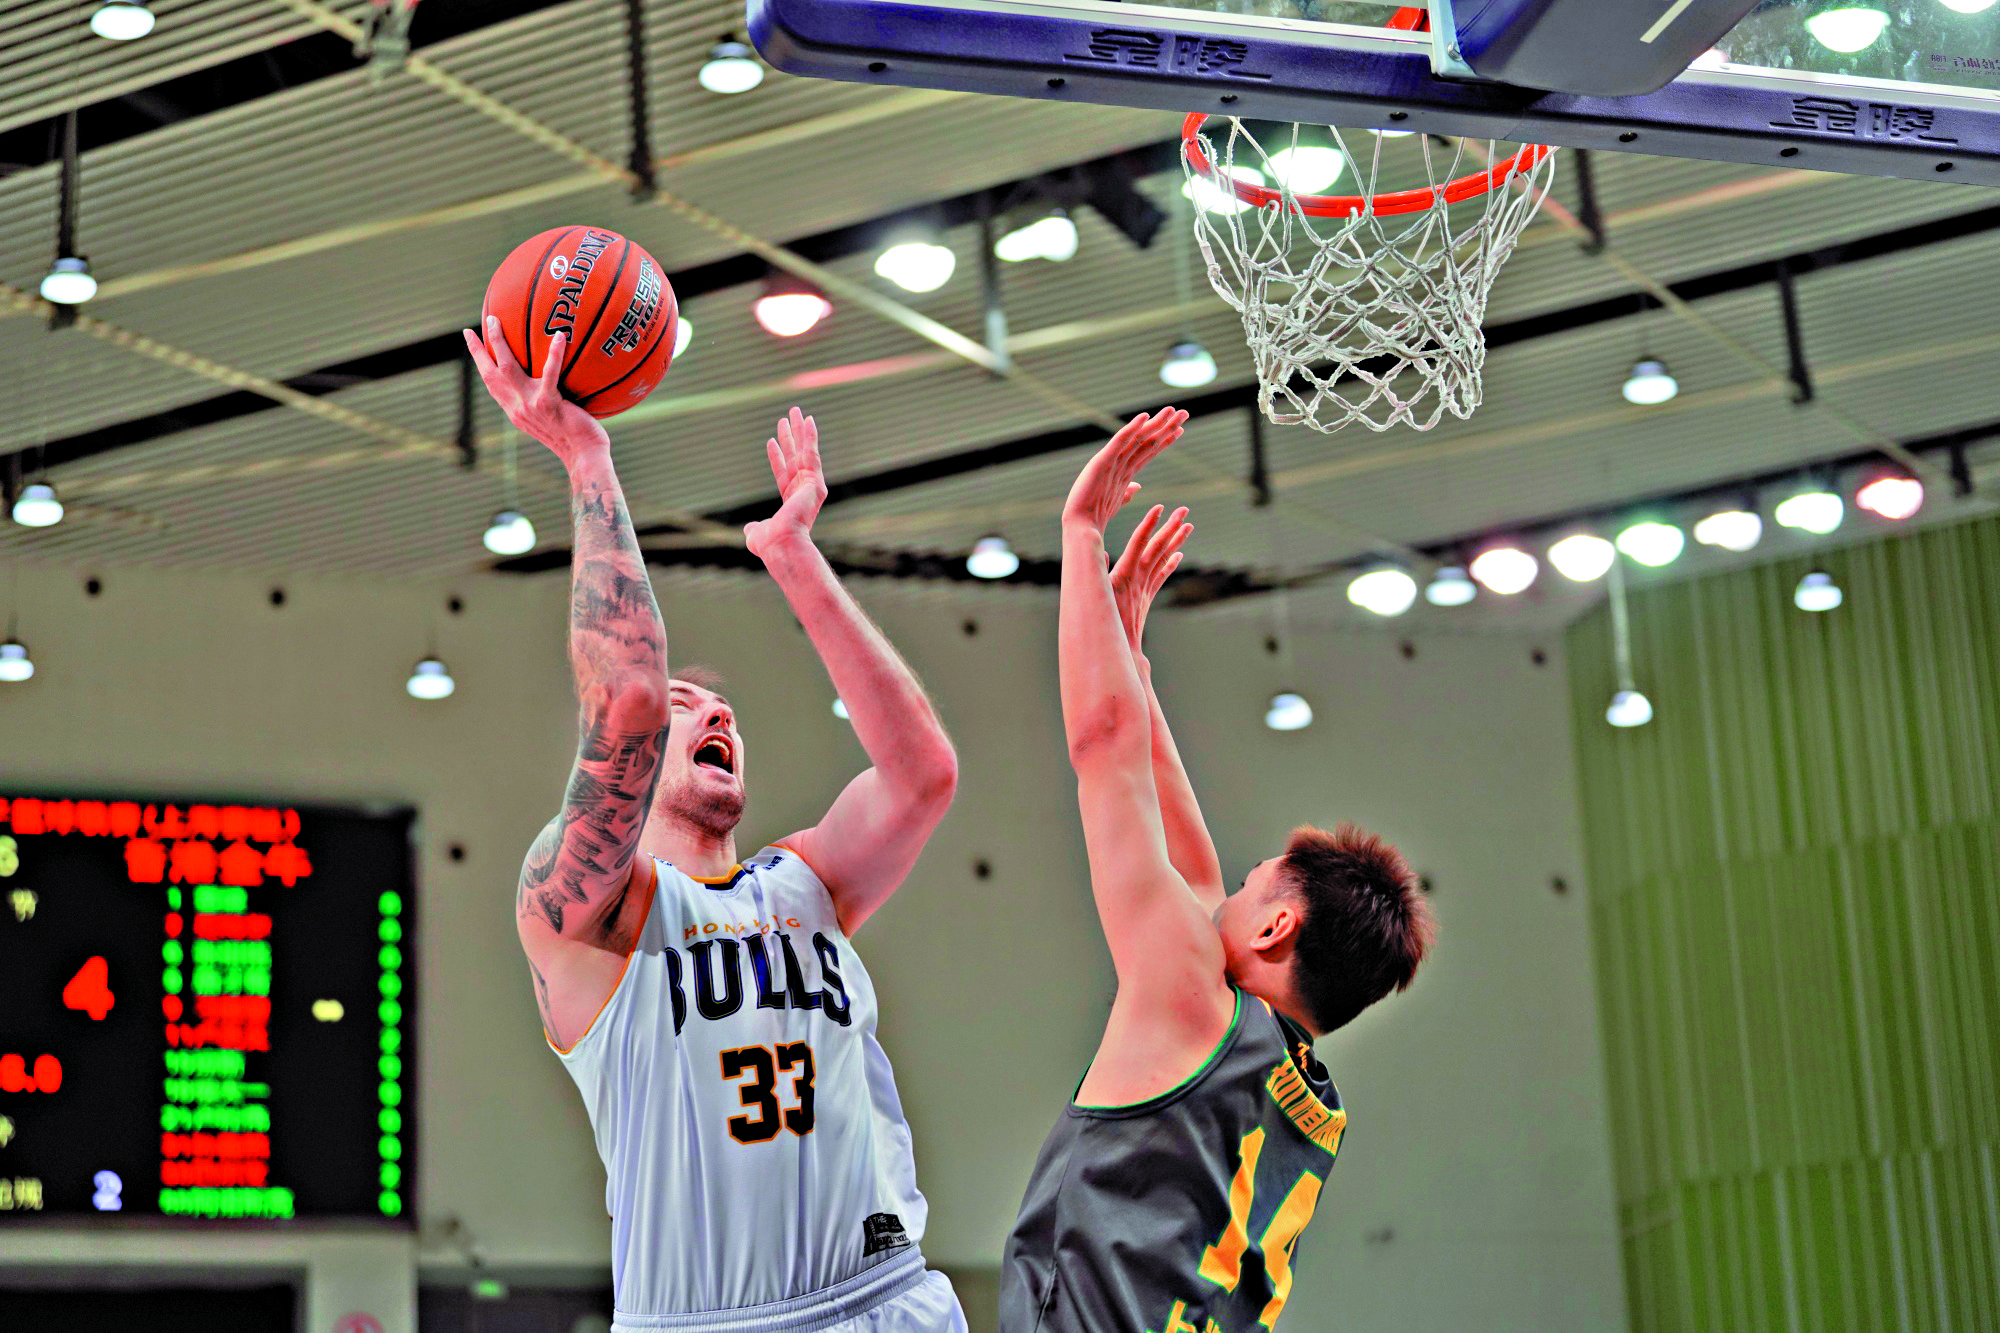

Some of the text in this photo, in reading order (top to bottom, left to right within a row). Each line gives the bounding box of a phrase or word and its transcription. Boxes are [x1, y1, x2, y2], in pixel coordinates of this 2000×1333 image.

[545, 230, 619, 343] SPALDING
[601, 256, 654, 358] PRECISION
[63, 956, 115, 1020] 4
[719, 1040, 816, 1145] 33
